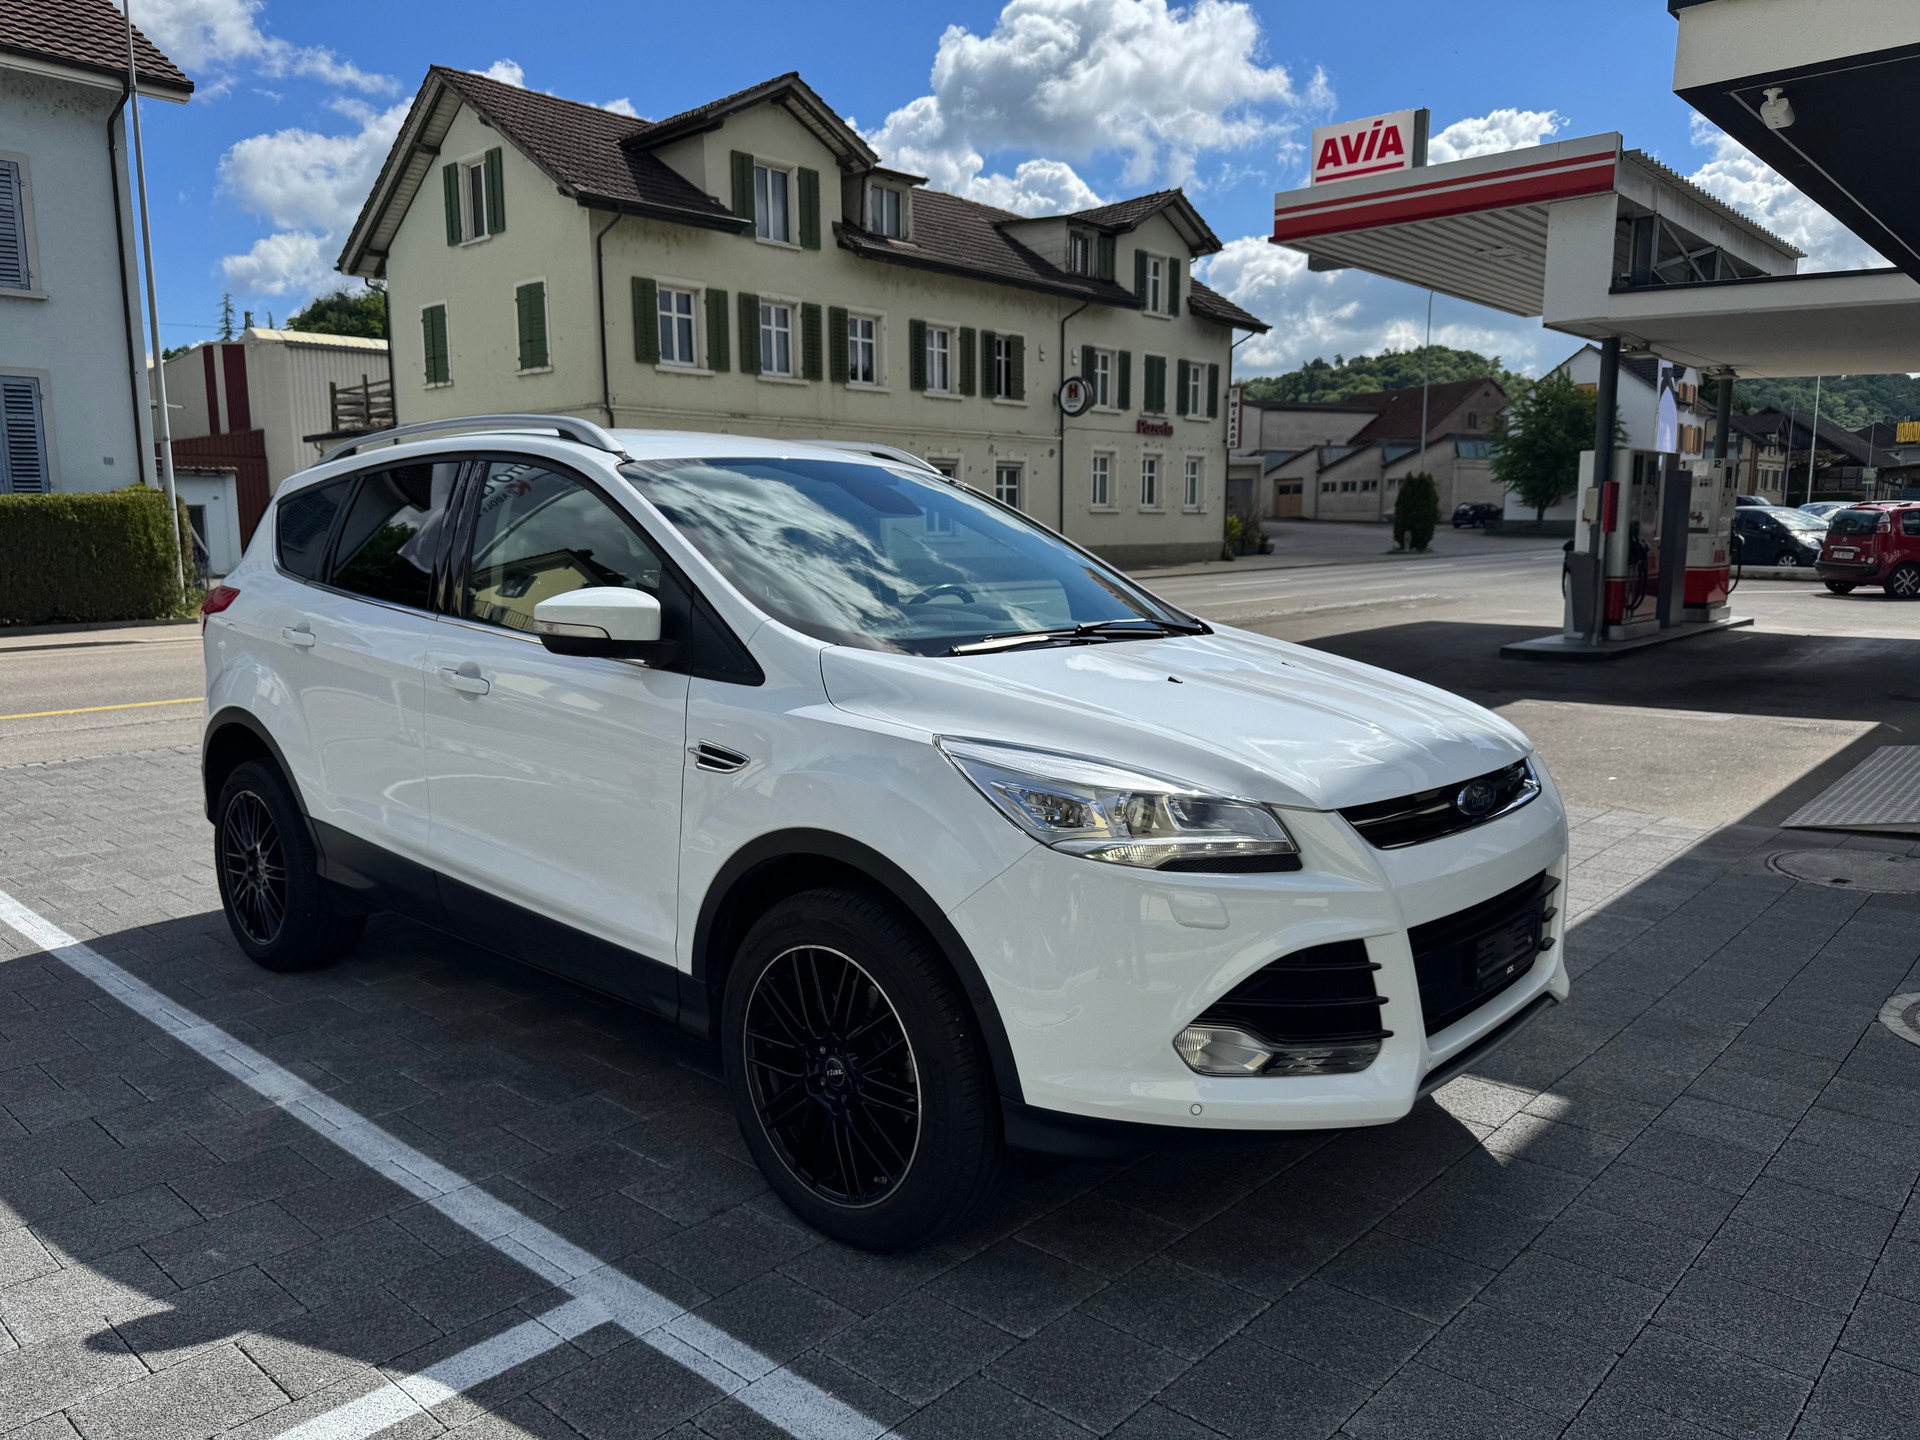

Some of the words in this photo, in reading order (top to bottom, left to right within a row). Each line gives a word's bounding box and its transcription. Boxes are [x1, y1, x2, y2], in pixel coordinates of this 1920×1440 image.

[1230, 401, 1238, 447] MIKADO
[1680, 460, 1686, 469] 1
[1714, 460, 1722, 468] 2
